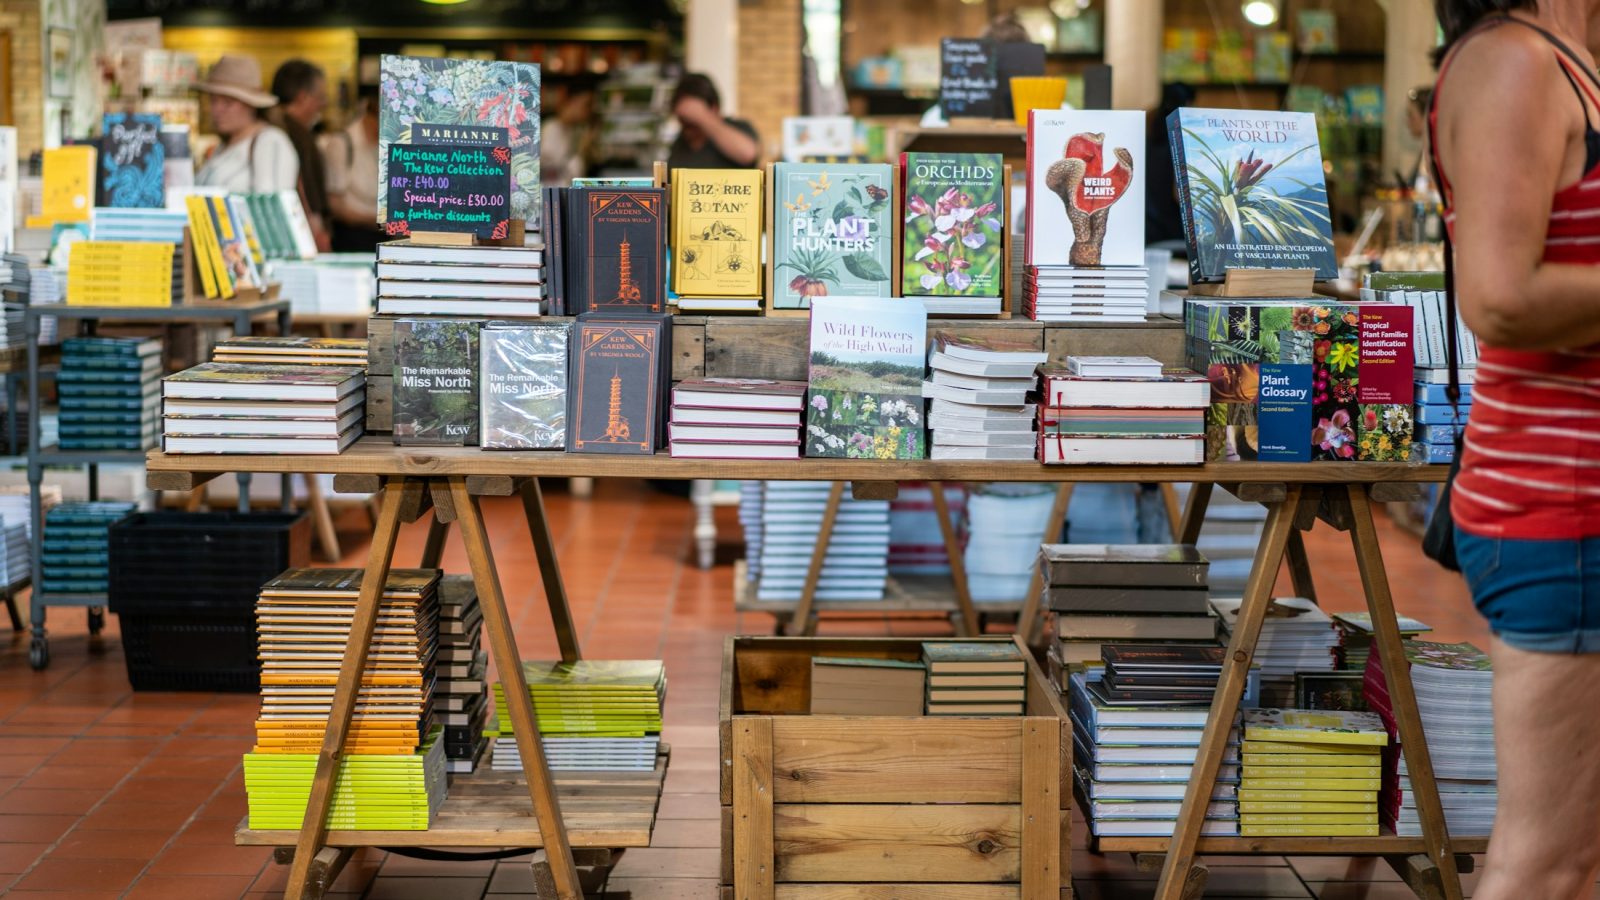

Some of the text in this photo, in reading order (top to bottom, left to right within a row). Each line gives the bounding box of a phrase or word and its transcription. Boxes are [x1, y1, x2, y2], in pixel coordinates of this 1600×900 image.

[1207, 118, 1298, 131] PLANTS OF THE
[421, 128, 499, 140] MARIANNE
[1222, 129, 1287, 144] WORLD
[391, 147, 487, 163] Marianne North
[403, 162, 505, 176] The Kew Collection
[915, 164, 994, 179] ORCHIDS
[391, 175, 449, 189] RRP: £40.00
[921, 179, 939, 187] Europe
[1083, 177, 1112, 186] WEIRD
[688, 183, 752, 196] BIZRRE
[1083, 186, 1115, 196] PLANTS
[404, 190, 504, 209] Special price: £30.00
[393, 208, 491, 222] no further discounts
[793, 217, 876, 237] PLANT
[792, 237, 876, 252] HUNTERS
[1226, 243, 1273, 252] ILLUSTRATED
[1275, 245, 1327, 253] ENCYCLOPEDIA
[1245, 252, 1282, 260] VASCULAR
[824, 321, 913, 341] Wild Flowers
[1362, 322, 1389, 331] Tropical
[824, 339, 913, 354] of the High Weald
[401, 366, 471, 375] The Remarkable
[402, 376, 471, 388] Miss North
[489, 373, 559, 382] The Remarkable
[1261, 375, 1290, 385] Plant
[490, 382, 519, 394] Miss
[1261, 386, 1308, 400] Glossary
[446, 424, 471, 435] Kew
